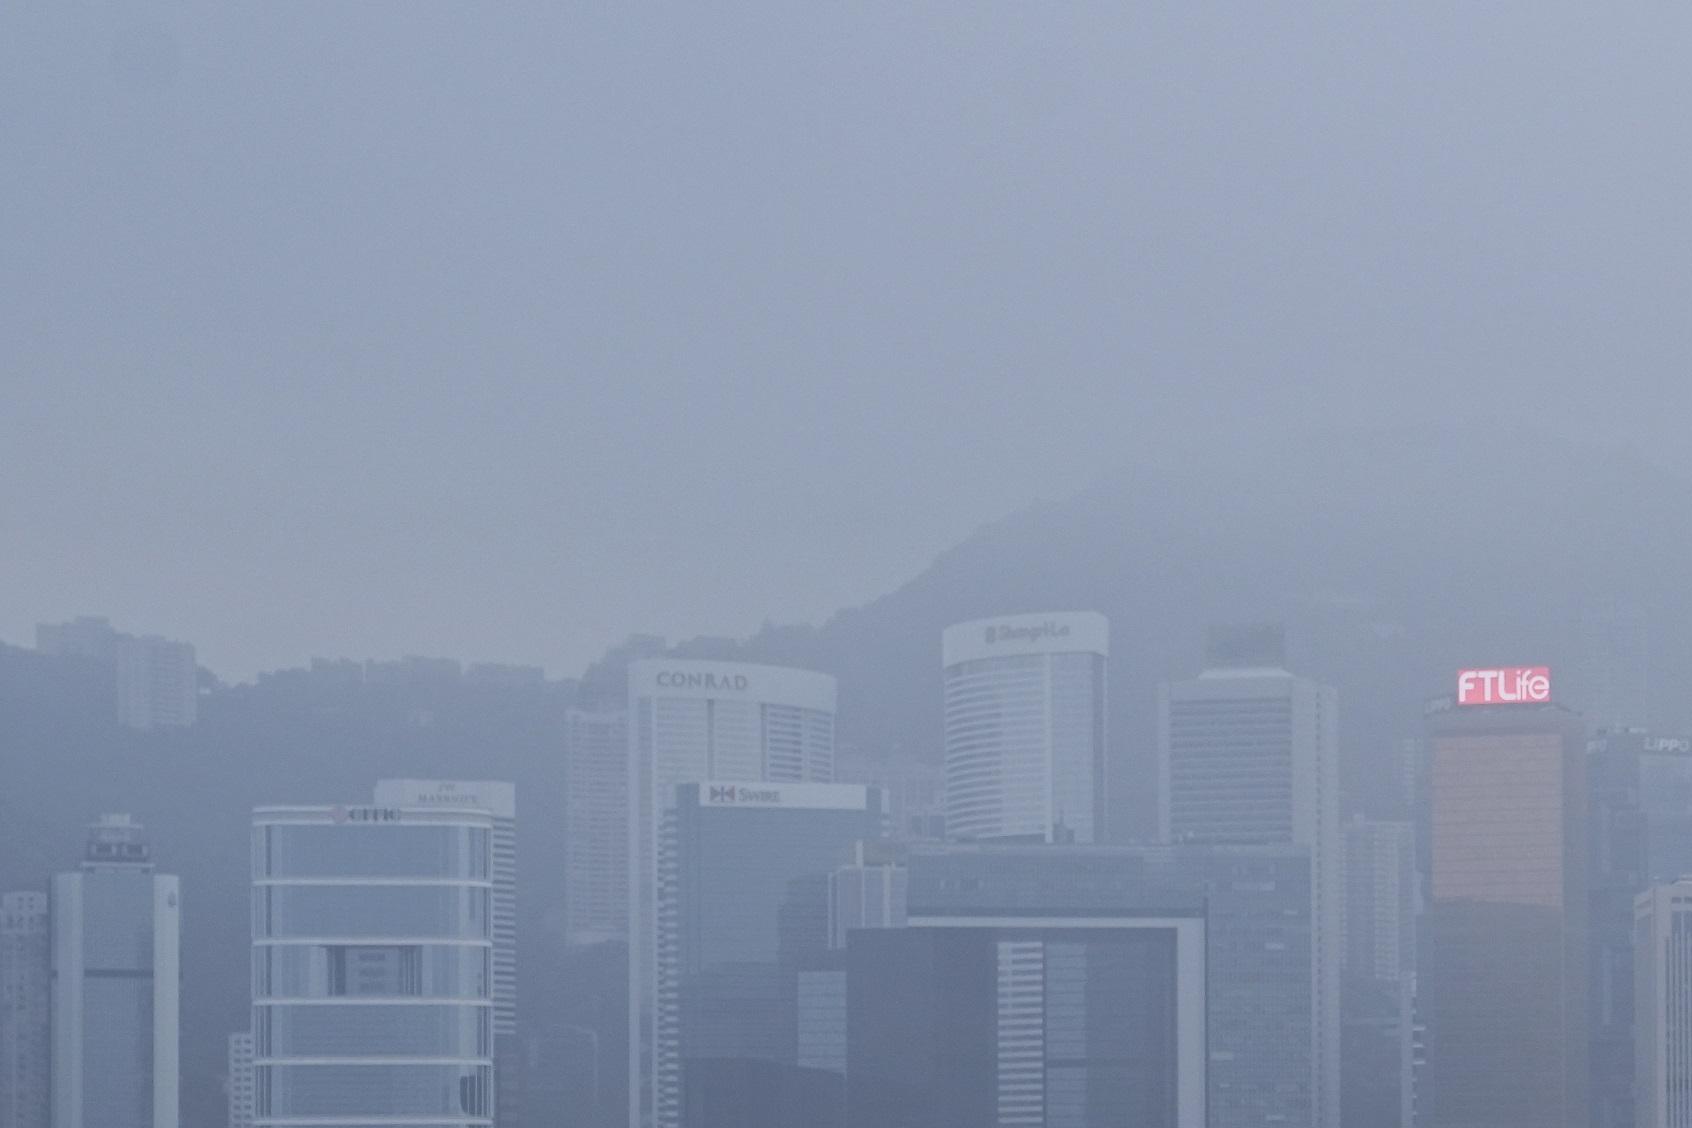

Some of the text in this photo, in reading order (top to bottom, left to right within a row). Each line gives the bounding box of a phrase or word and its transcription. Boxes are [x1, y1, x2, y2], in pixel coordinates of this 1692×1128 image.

[656, 671, 748, 691] CONRAD
[1457, 669, 1550, 703] FTLife
[1643, 736, 1689, 752] LIPPO
